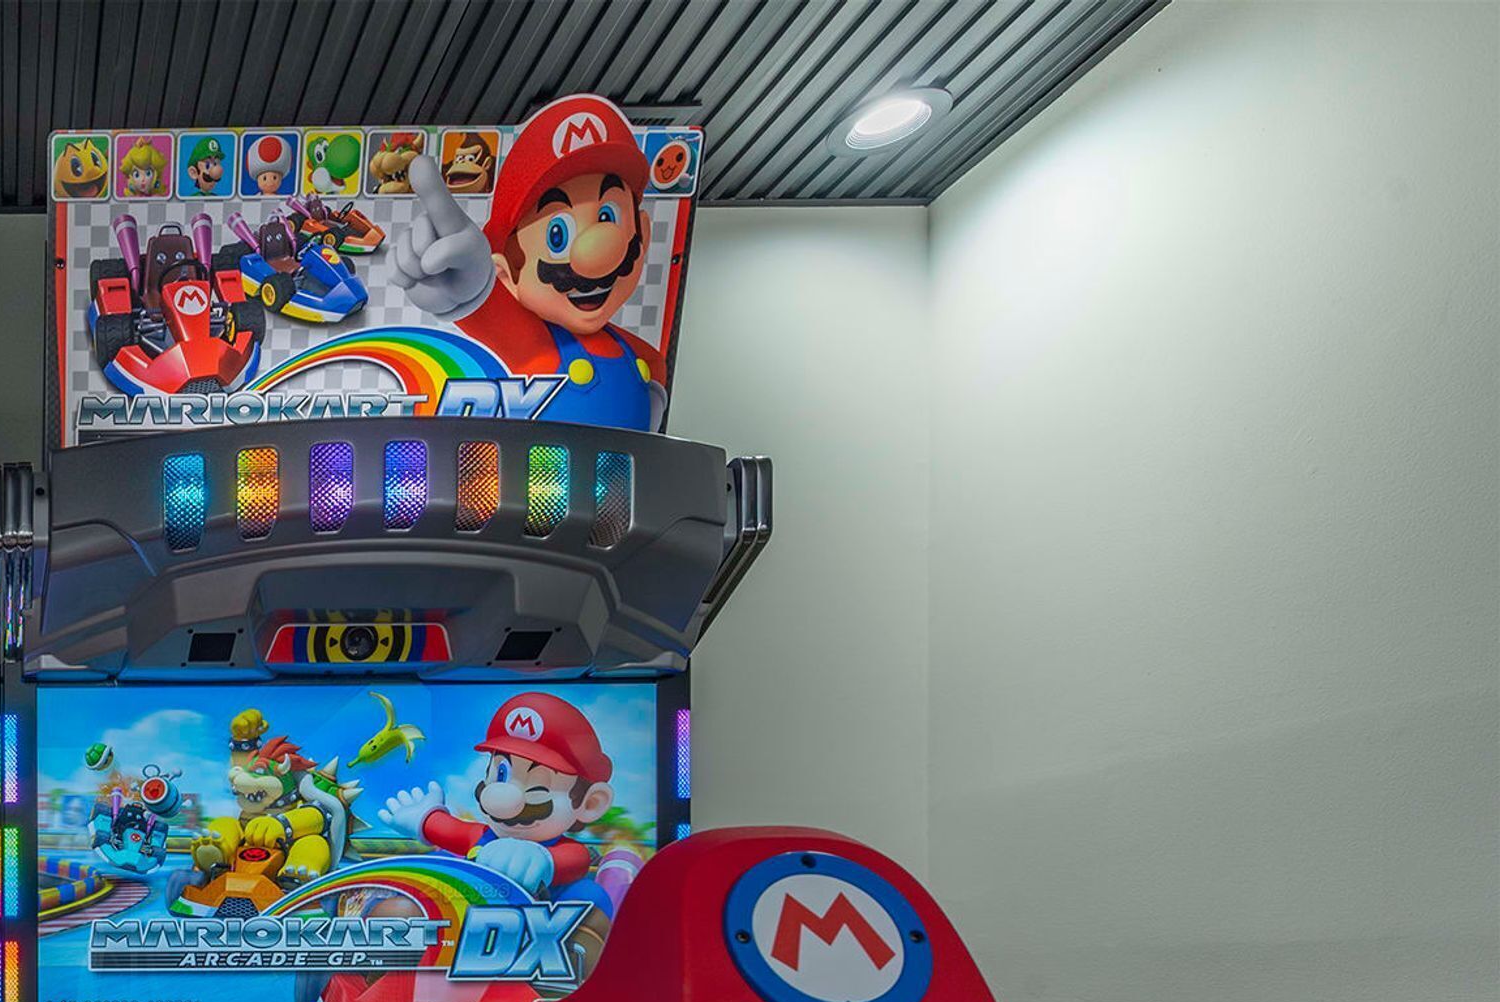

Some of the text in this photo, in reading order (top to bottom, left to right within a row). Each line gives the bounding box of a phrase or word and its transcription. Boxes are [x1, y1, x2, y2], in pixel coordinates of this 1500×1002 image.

[560, 116, 604, 156] M
[178, 289, 206, 308] M
[509, 713, 536, 736] M
[449, 902, 593, 979] DX
[771, 892, 896, 972] M
[179, 952, 308, 966] ARCADE
